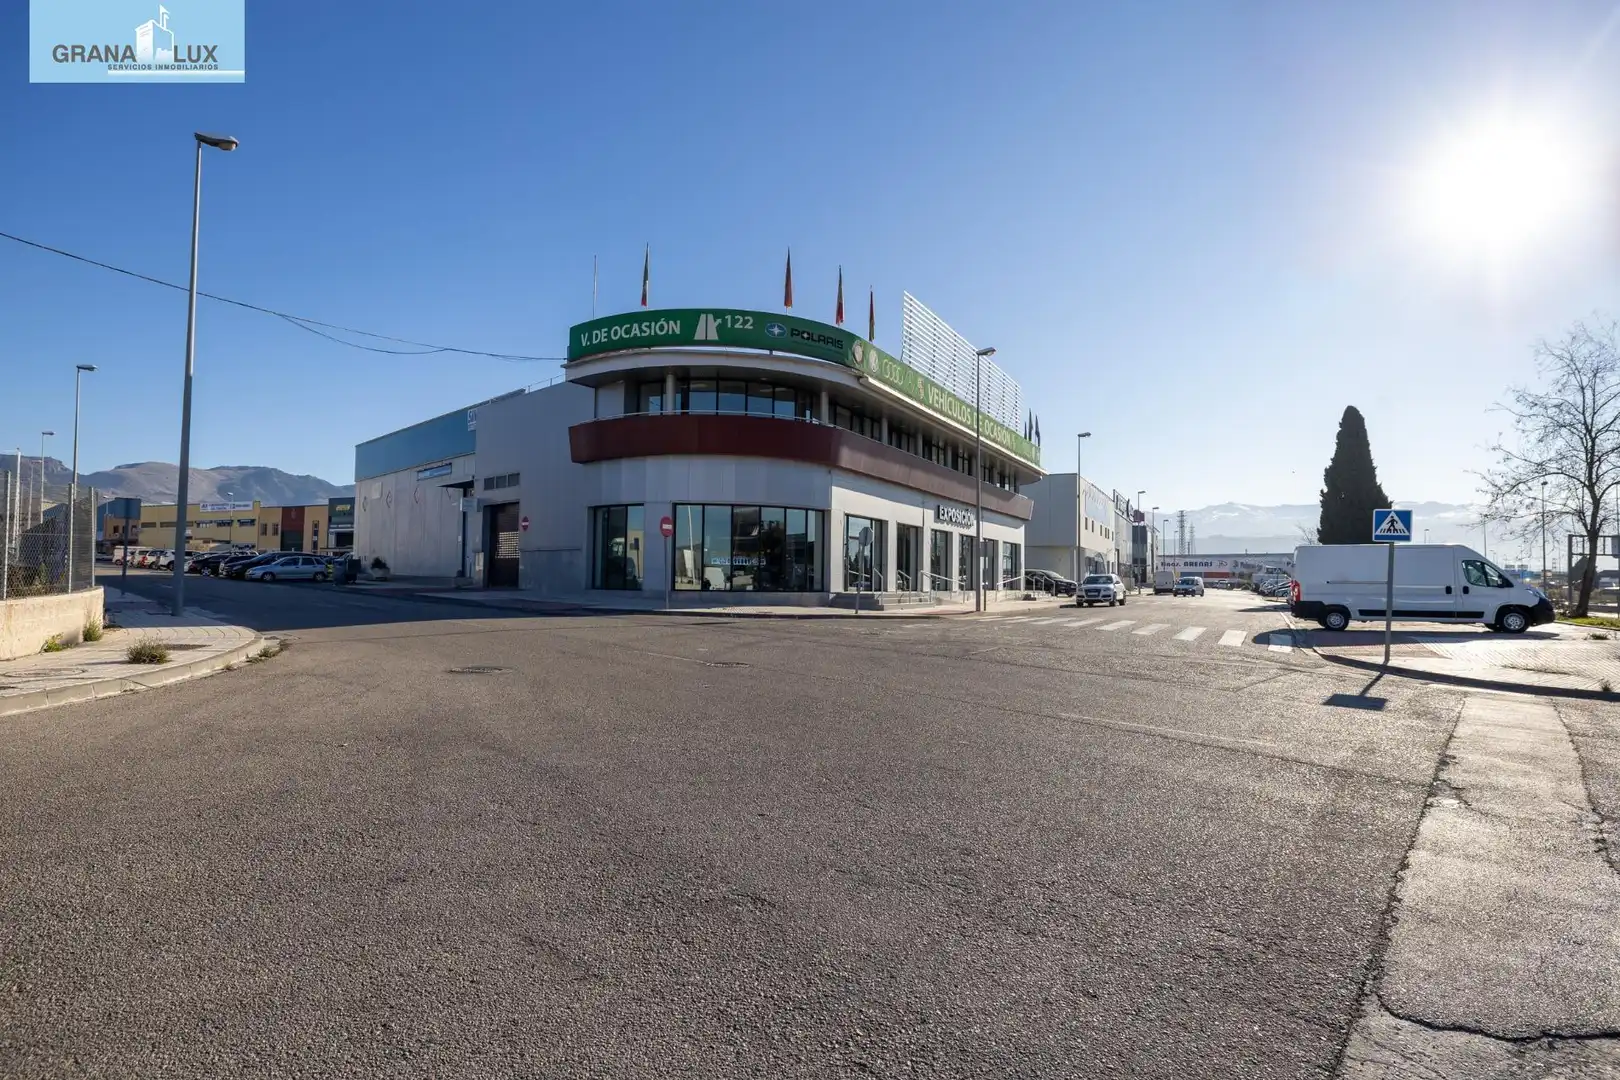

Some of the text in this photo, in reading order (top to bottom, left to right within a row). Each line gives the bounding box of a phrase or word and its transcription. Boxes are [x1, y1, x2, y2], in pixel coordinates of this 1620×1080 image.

[580, 317, 681, 347] V. DE OCASIÓN
[724, 314, 754, 330] 122
[790, 327, 844, 350] POLARIS
[928, 383, 971, 425] VEHÍCULOS
[984, 419, 1012, 449] OCASIÓN
[939, 504, 976, 526] EXPOSICIÓN
